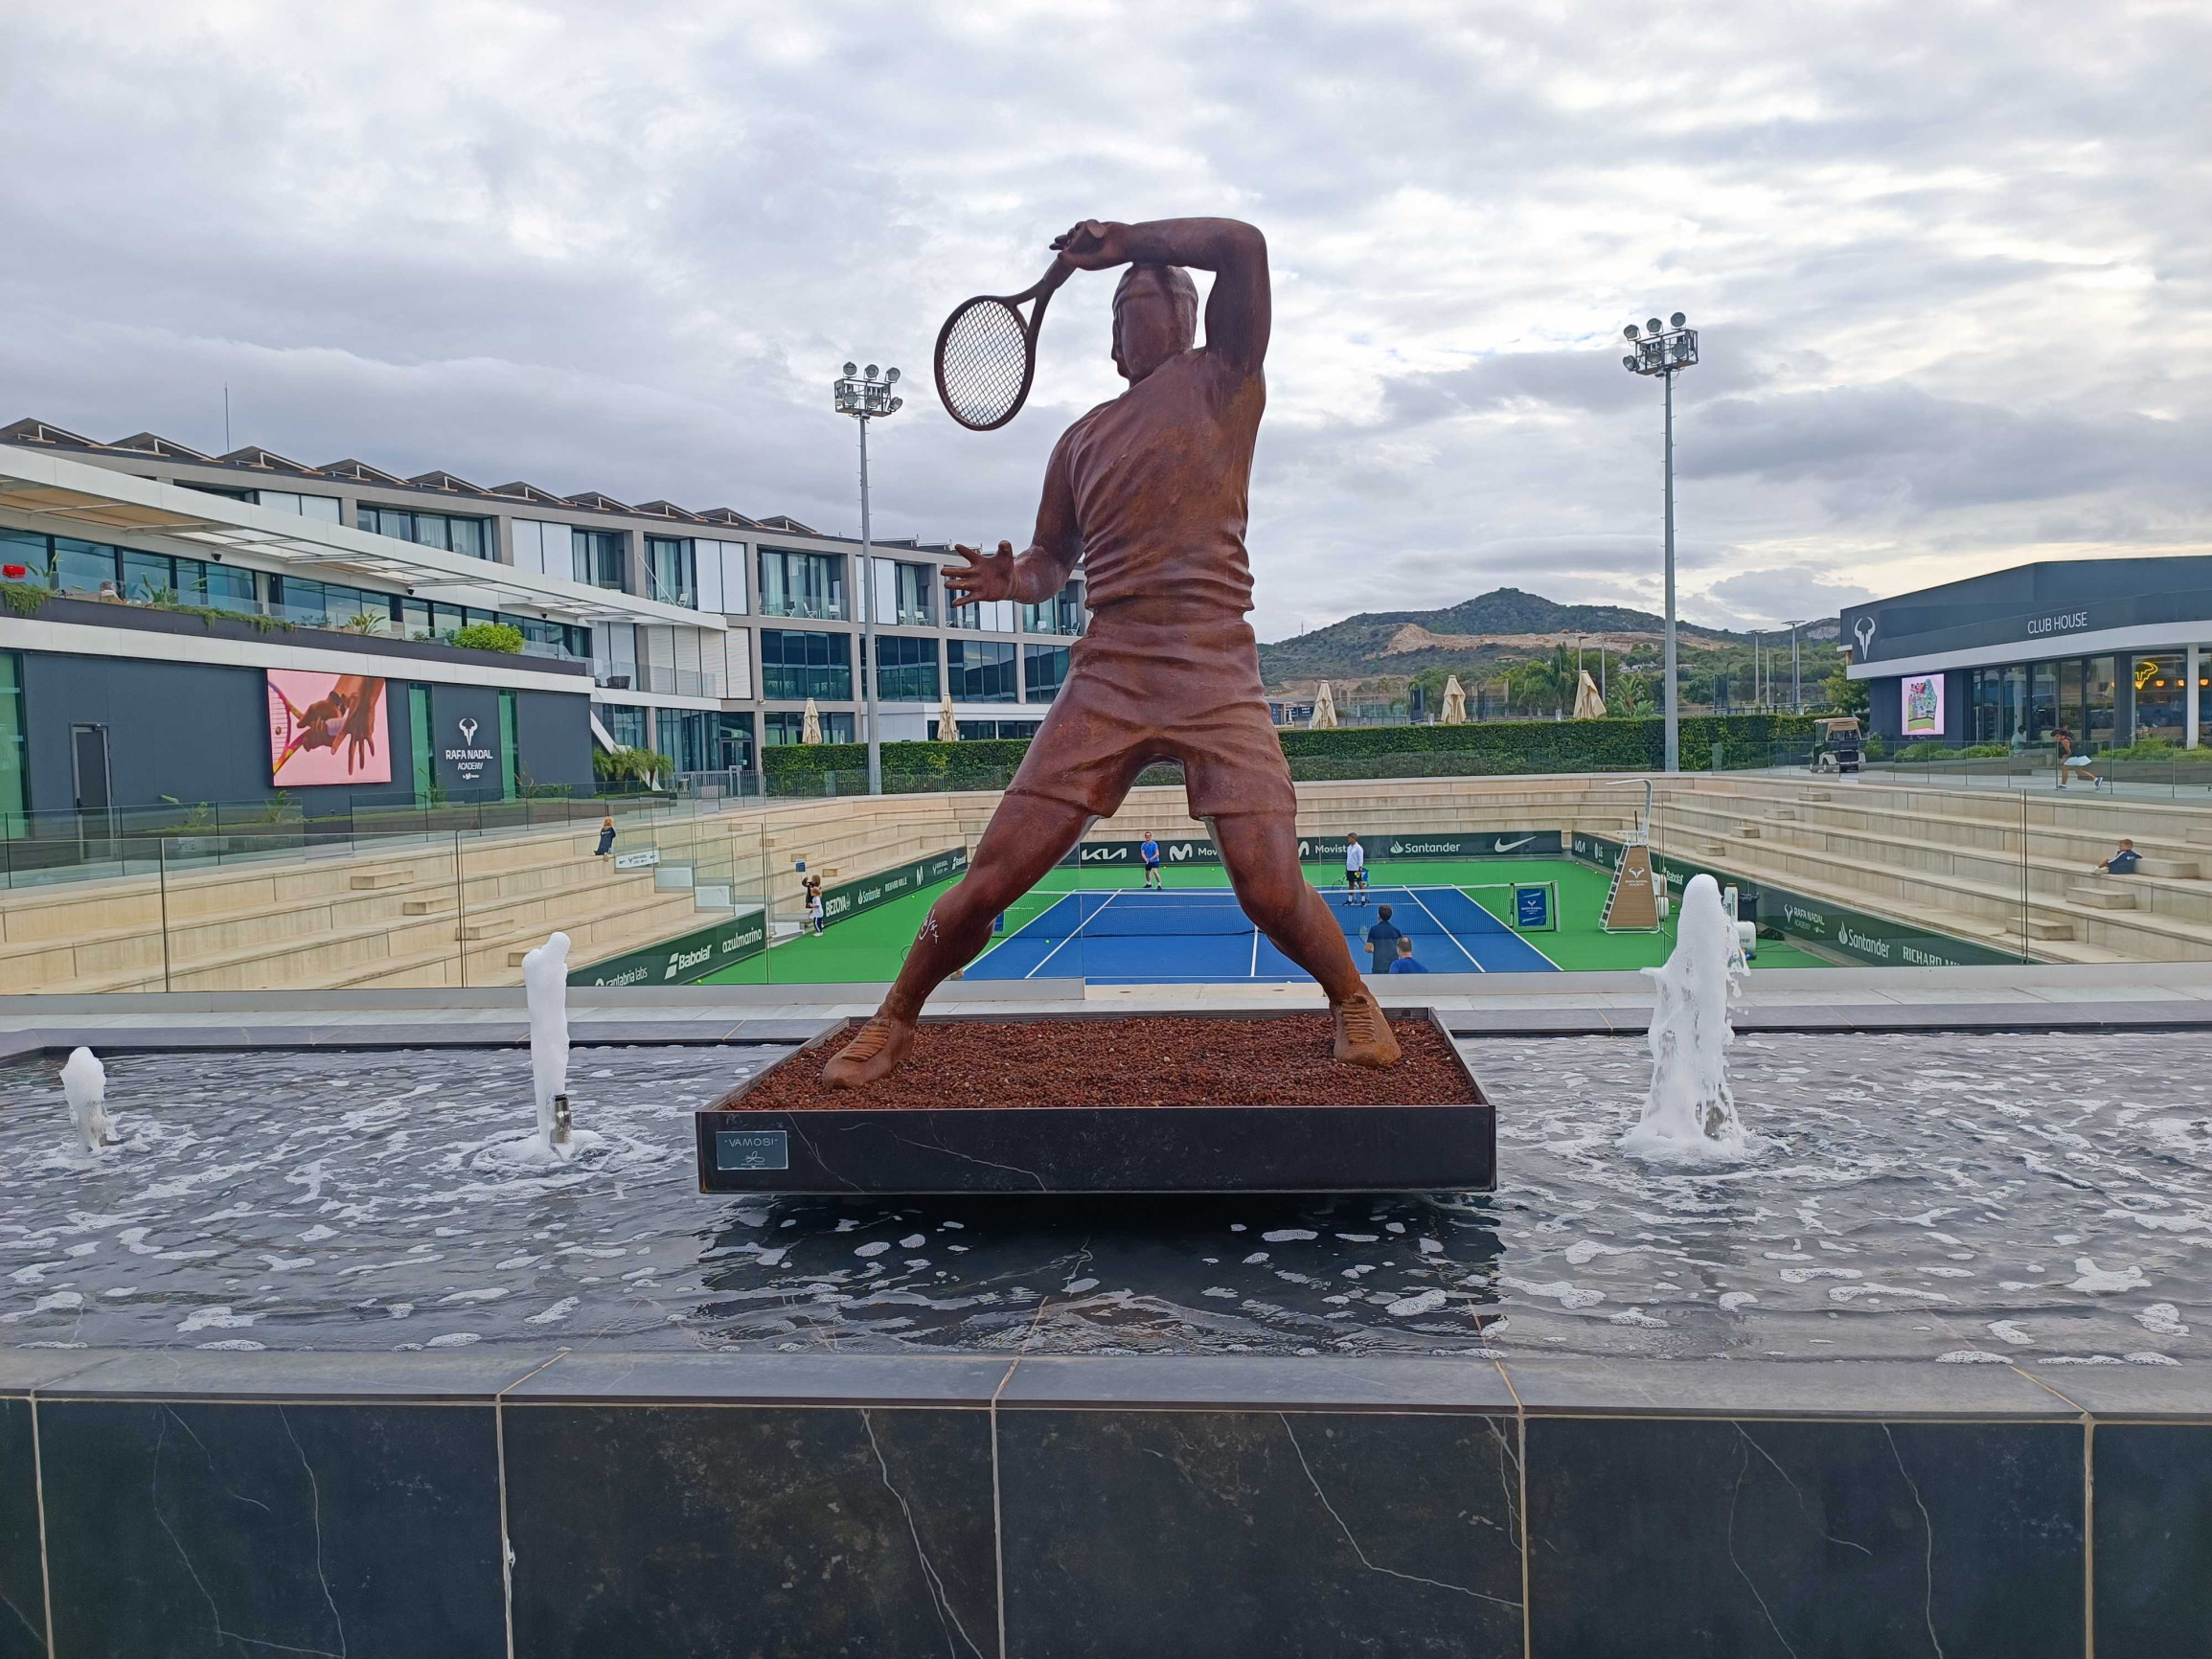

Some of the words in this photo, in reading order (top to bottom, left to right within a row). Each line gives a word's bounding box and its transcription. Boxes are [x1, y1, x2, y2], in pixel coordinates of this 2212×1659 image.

[2027, 618, 2052, 634] CLUB
[2054, 611, 2088, 630] HOUSE
[445, 749, 467, 761] RAFA
[467, 749, 494, 760] NADAL
[457, 761, 484, 771] ACADEMY
[1197, 847, 1218, 856] Mov
[1314, 844, 1348, 854] Movist
[1404, 842, 1462, 854] Santander
[825, 895, 847, 918] BEZOYA
[1793, 907, 1808, 920] RAFA
[1807, 911, 1825, 925] NADAL
[721, 926, 763, 954] azulmarino
[1848, 928, 1890, 959] Santander
[678, 944, 712, 970] Babolat
[1903, 945, 1943, 966] RICHARD
[635, 966, 648, 981] labs
